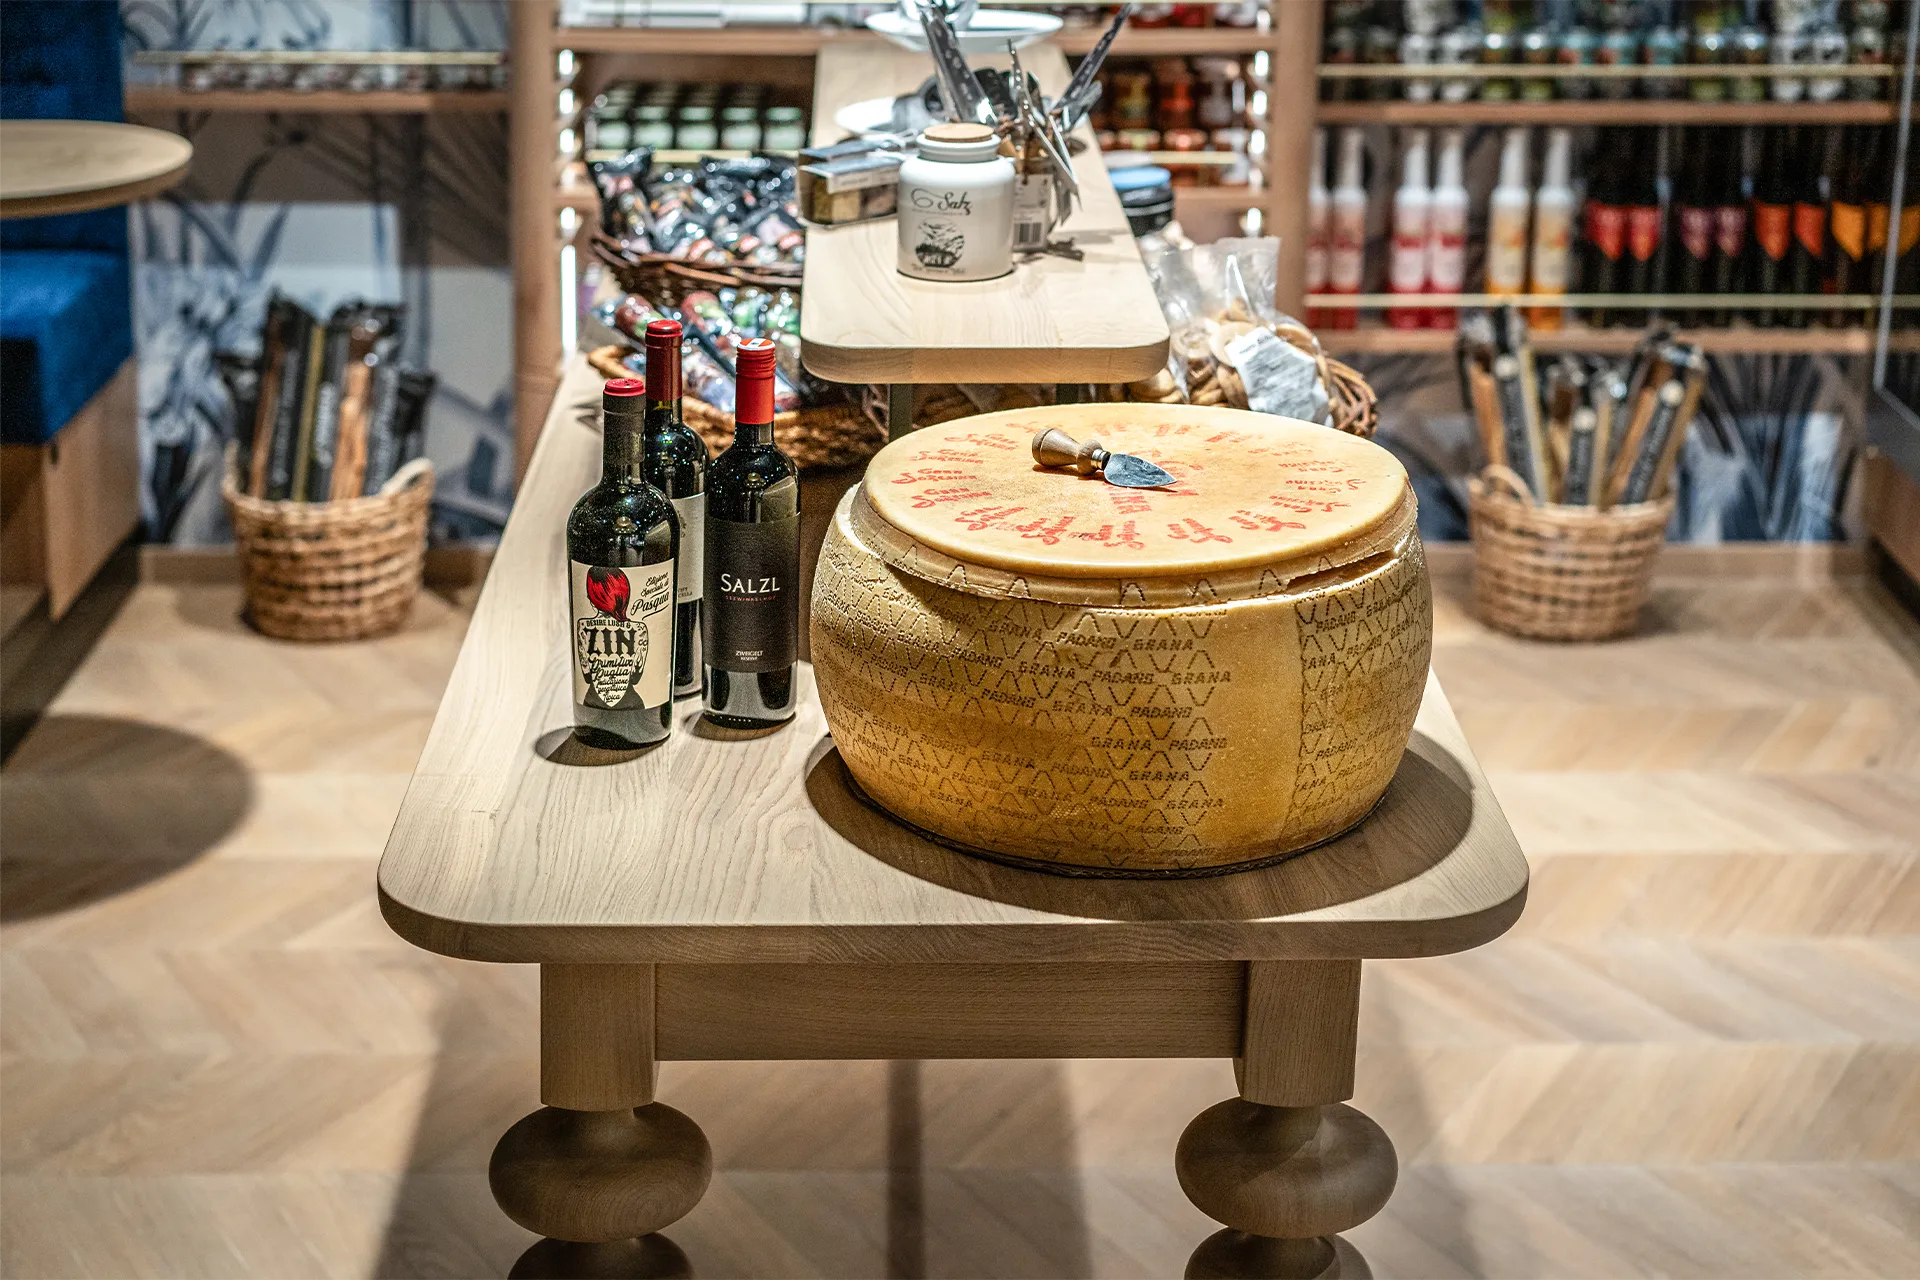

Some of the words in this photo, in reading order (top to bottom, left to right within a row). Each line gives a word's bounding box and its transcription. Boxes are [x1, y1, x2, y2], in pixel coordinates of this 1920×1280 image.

[914, 188, 972, 216] Salz
[721, 573, 780, 594] SALZL
[629, 591, 669, 616] Pasqua
[583, 627, 637, 656] ZIN
[989, 620, 1041, 640] GRANA
[1057, 632, 1117, 648] PADANO
[1132, 638, 1193, 651] GRANA
[592, 666, 630, 682] Puglia
[1019, 660, 1076, 680] GRANA
[1092, 670, 1155, 684] PADANO
[1170, 670, 1231, 685] GRANA
[980, 687, 1037, 709] PADANO
[1051, 700, 1112, 716] GRANA
[1129, 706, 1193, 719] PADANO
[1091, 736, 1151, 751] GRANA
[1168, 737, 1227, 751] PADANO
[1128, 769, 1189, 782] GRANA
[1165, 799, 1224, 810] GRANA
